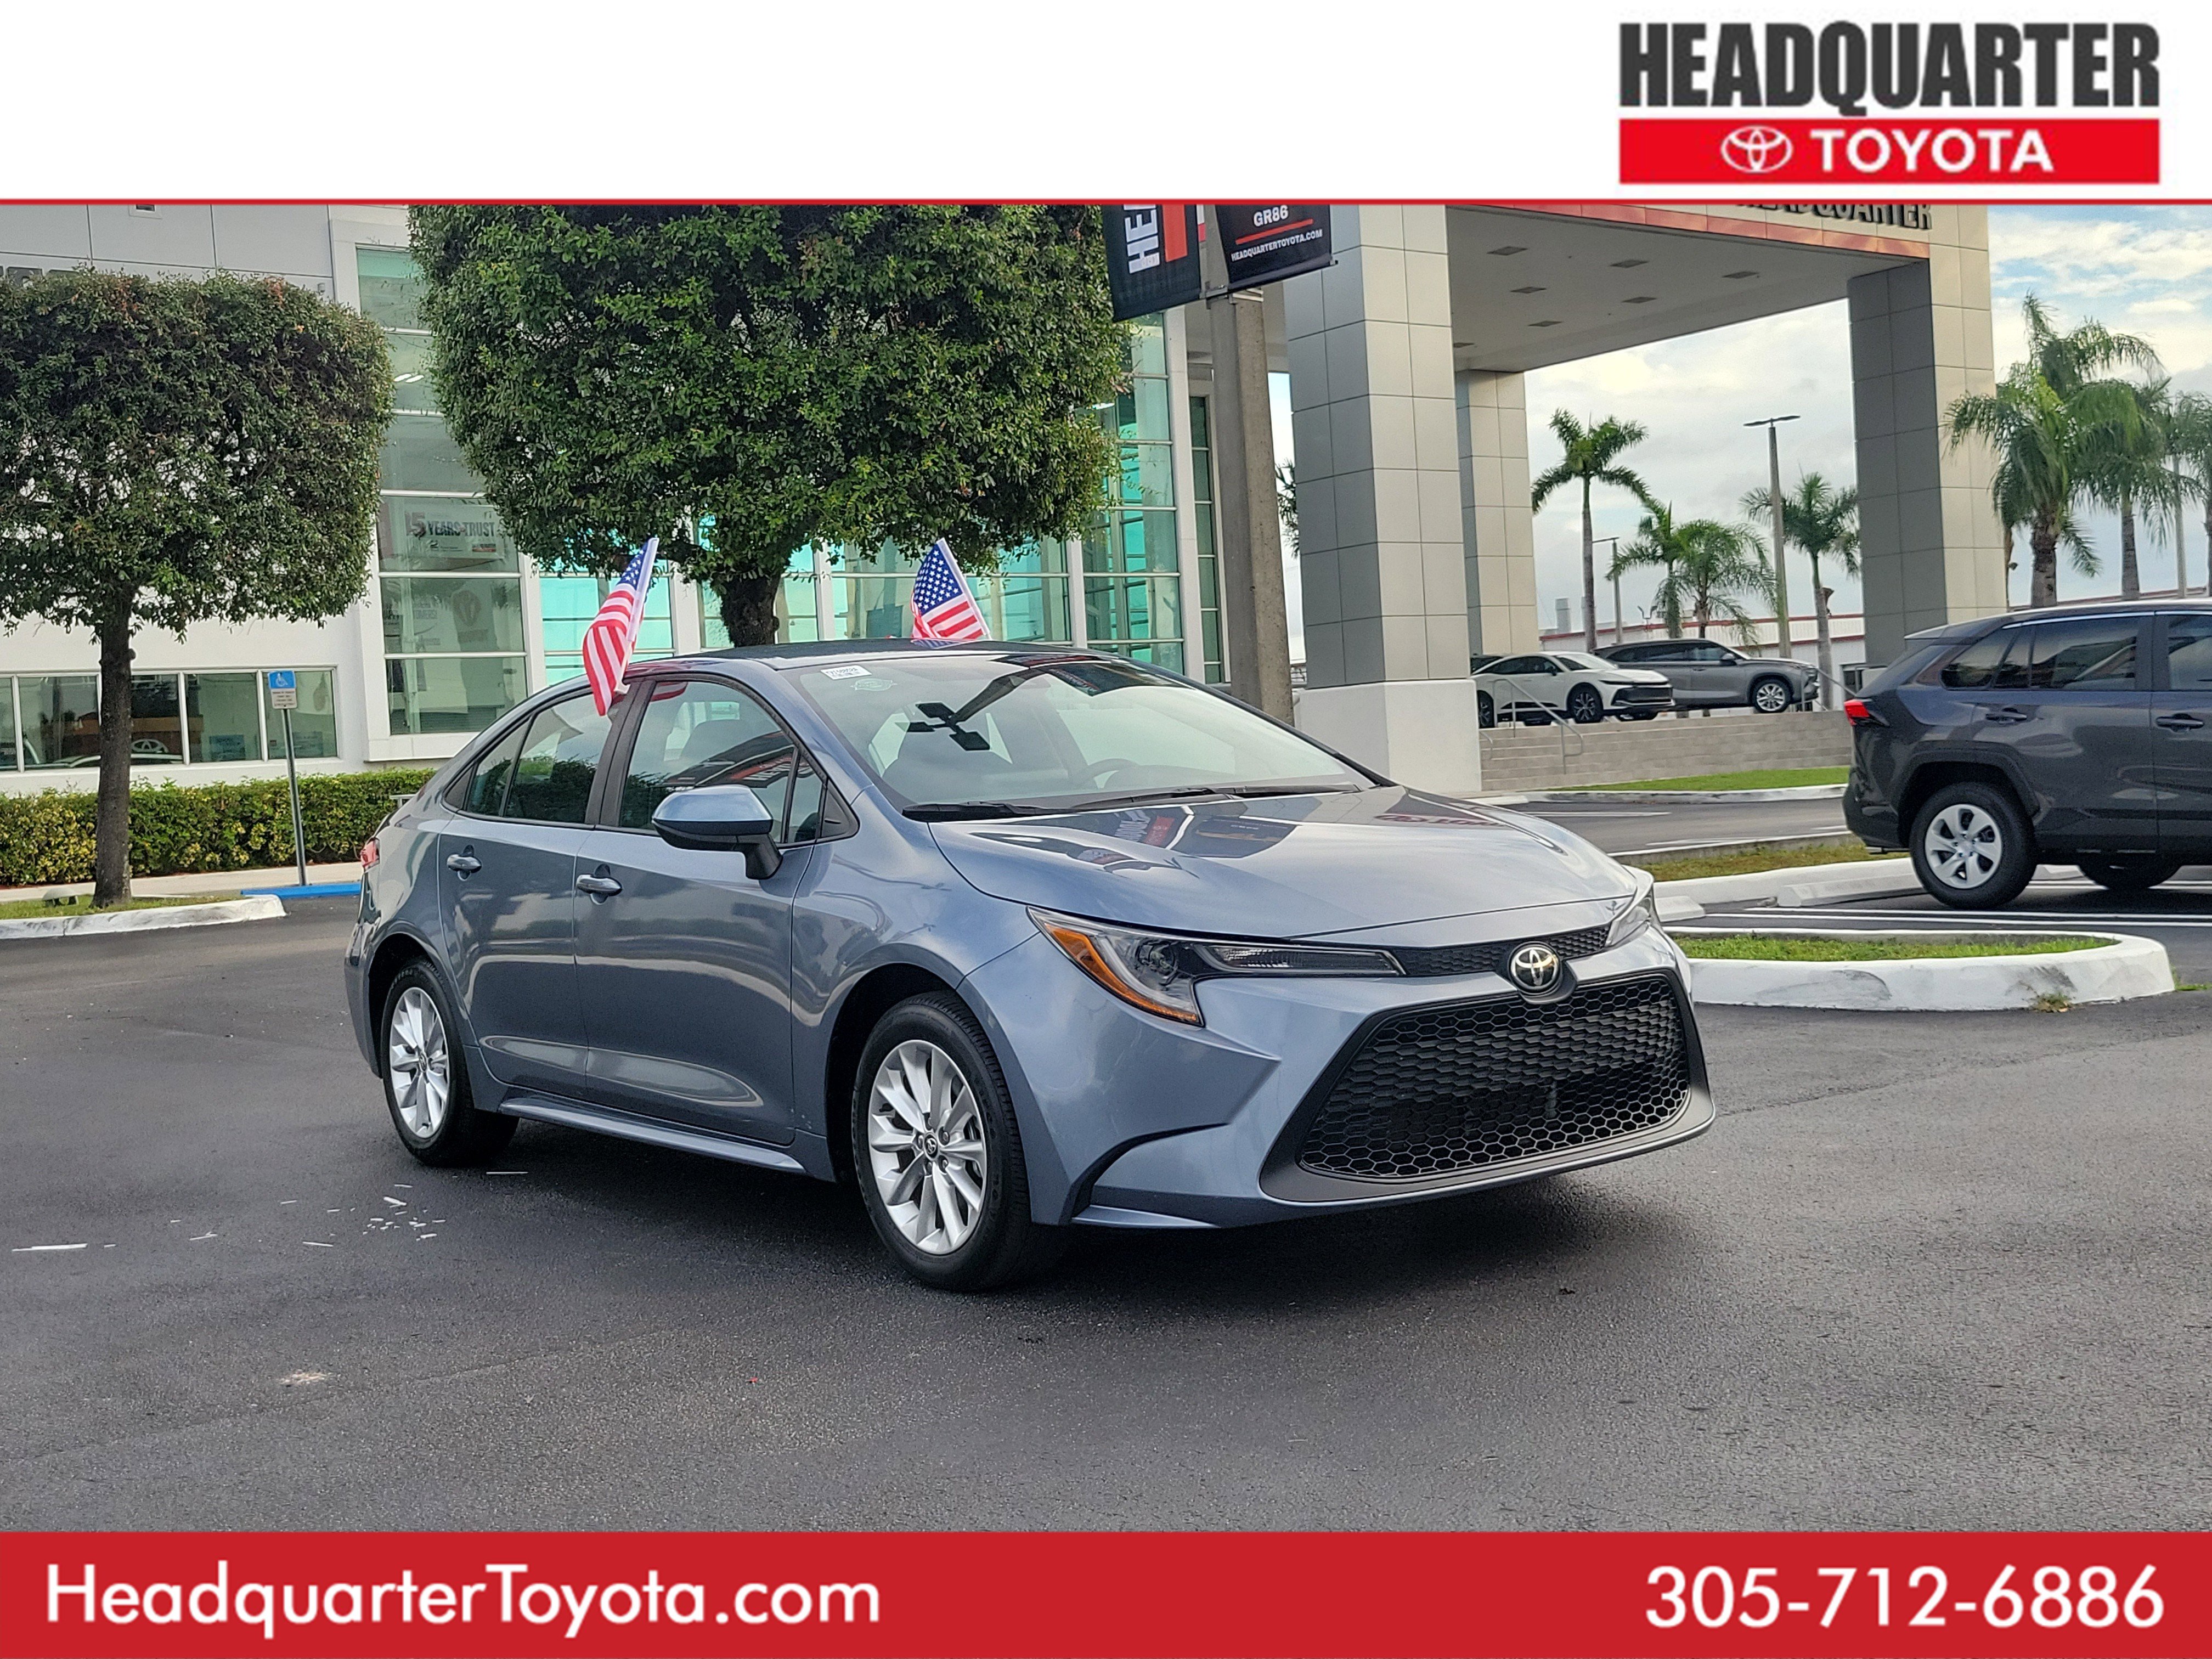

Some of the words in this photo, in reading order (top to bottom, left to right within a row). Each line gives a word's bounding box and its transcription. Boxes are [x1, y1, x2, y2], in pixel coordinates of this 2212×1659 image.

[1254, 205, 1289, 227] GR86
[1736, 205, 1932, 230] UARTER
[1123, 205, 1160, 274] HE
[1231, 229, 1323, 262] HEADQUARTERTOYOTA.COM
[462, 522, 495, 537] TRUST
